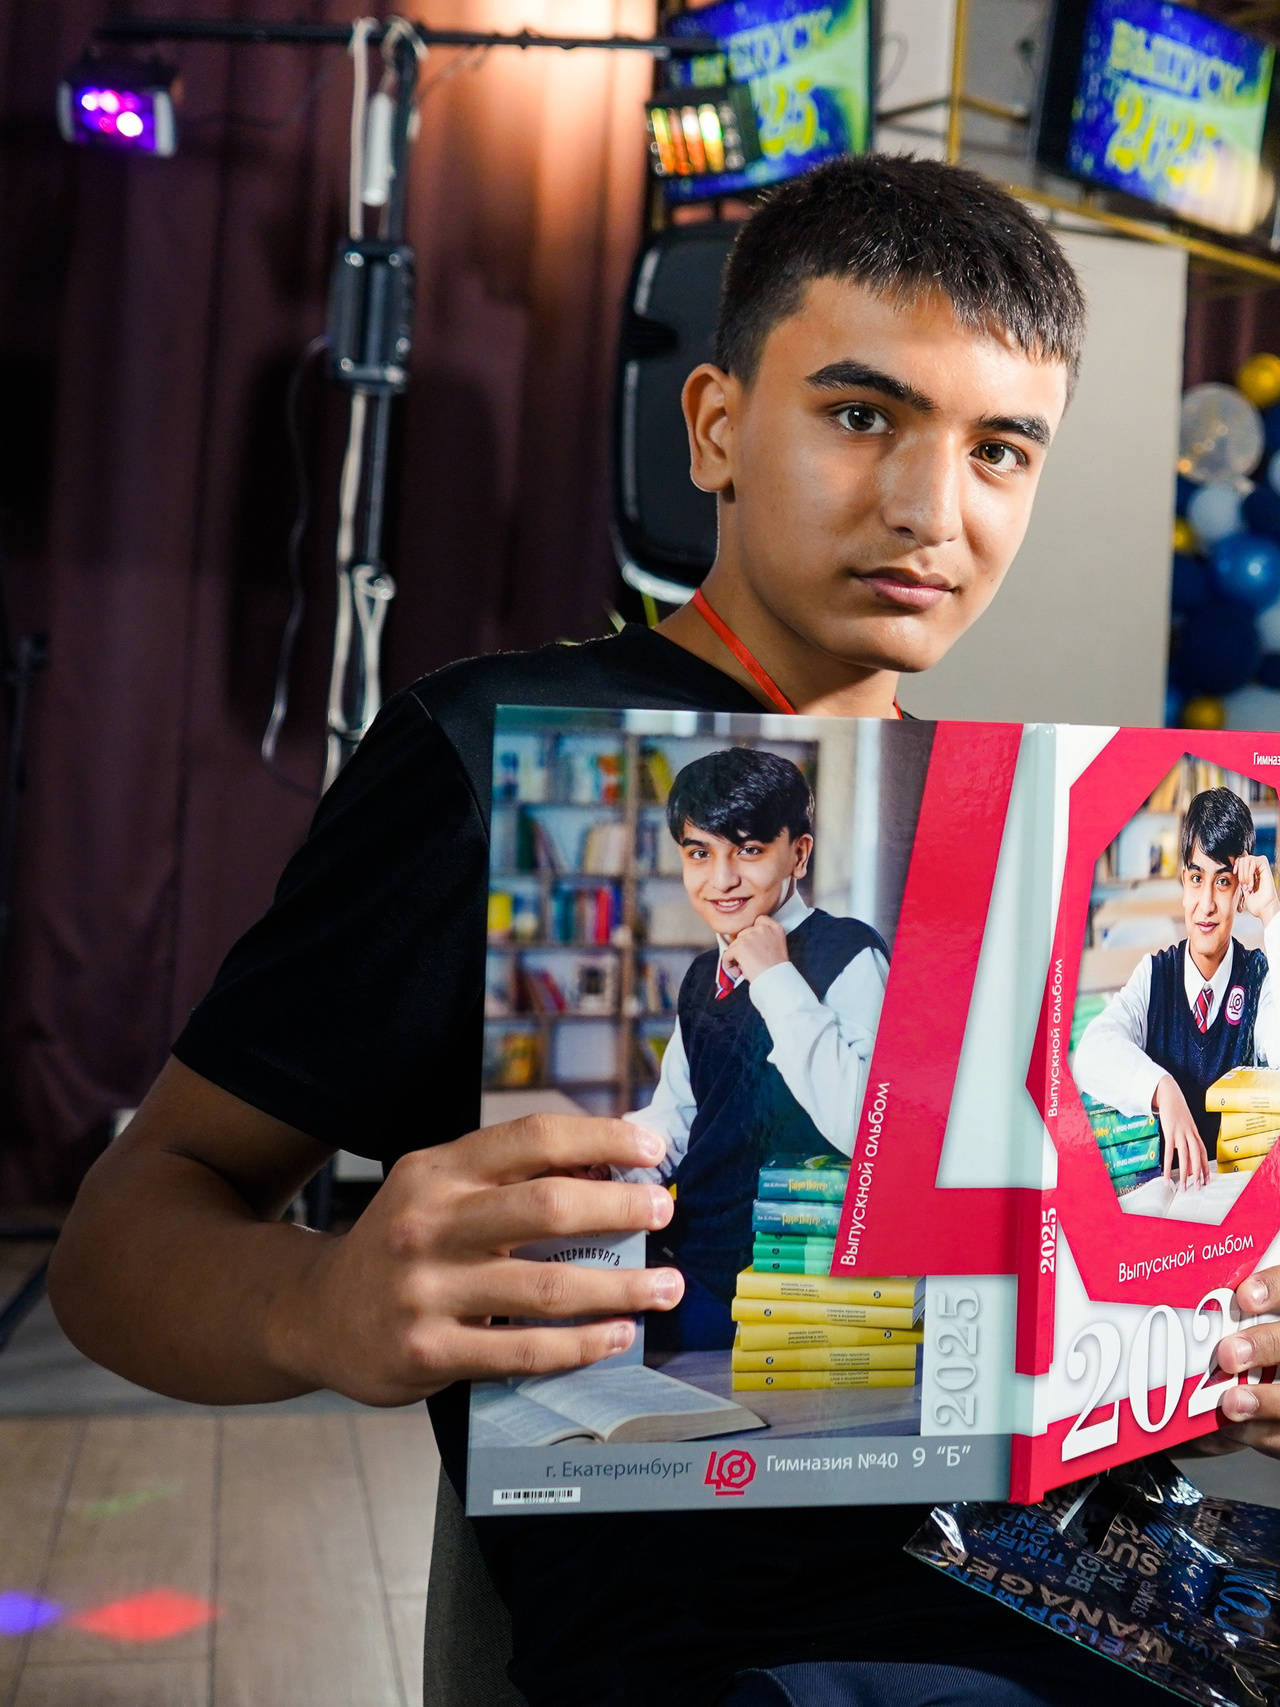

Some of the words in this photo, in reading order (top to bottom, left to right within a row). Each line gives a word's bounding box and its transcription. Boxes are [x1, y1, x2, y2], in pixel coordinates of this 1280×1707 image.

[1052, 959, 1063, 1024] альбом
[1048, 1028, 1061, 1118] Выпускной
[840, 1162, 875, 1266] Выпускной
[865, 1082, 890, 1157] альбом
[1039, 1206, 1058, 1274] 2025
[1118, 1243, 1196, 1283] Выпускной
[1201, 1234, 1254, 1262] альбом
[933, 1286, 978, 1427] 2025
[1061, 1286, 1242, 1462] 202
[546, 1465, 557, 1478] г.
[562, 1457, 692, 1479] Екатеринбург
[767, 1455, 852, 1471] Гимназия
[857, 1452, 898, 1469] №40
[911, 1447, 926, 1468] 9
